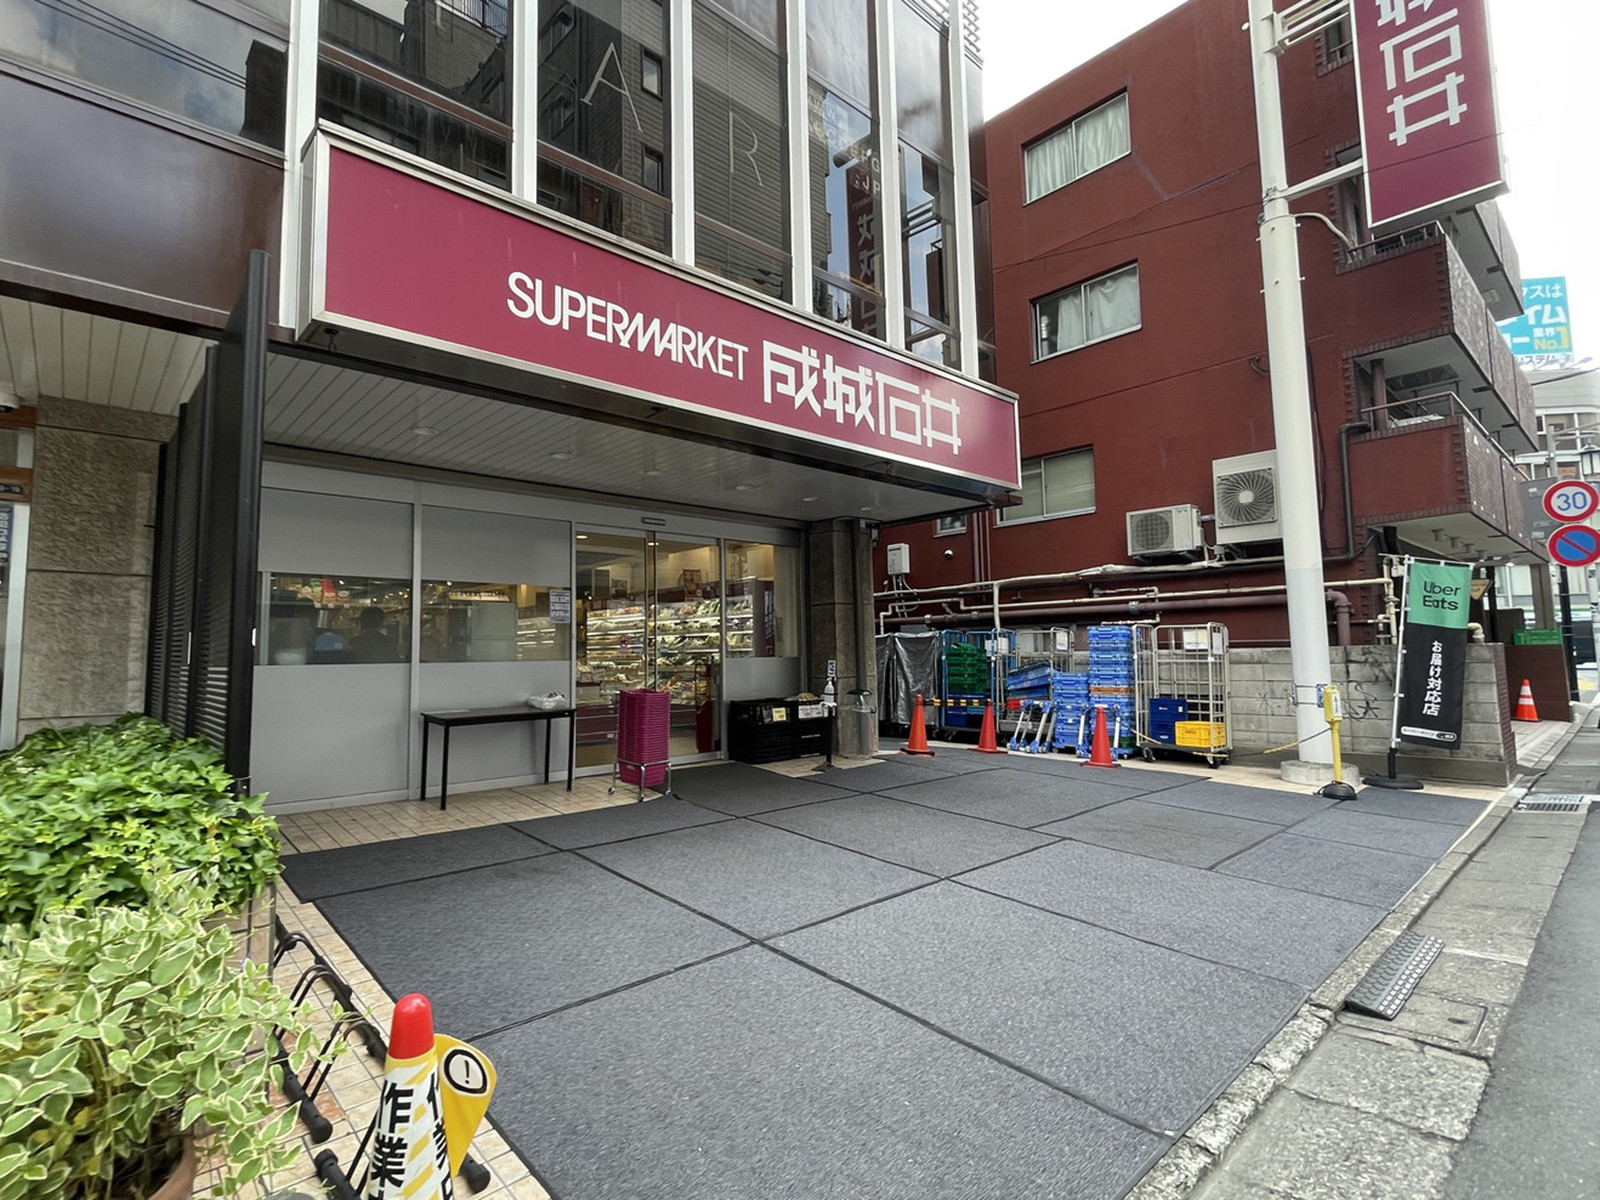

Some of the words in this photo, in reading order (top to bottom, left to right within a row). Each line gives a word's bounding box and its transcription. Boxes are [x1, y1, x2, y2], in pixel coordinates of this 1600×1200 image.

[507, 271, 748, 381] SUPERMARKET
[762, 339, 962, 455] 成城石井
[1556, 491, 1588, 512] 30
[1423, 580, 1461, 596] Uber
[1422, 595, 1459, 611] Eats
[1422, 640, 1443, 717] お届け対応店
